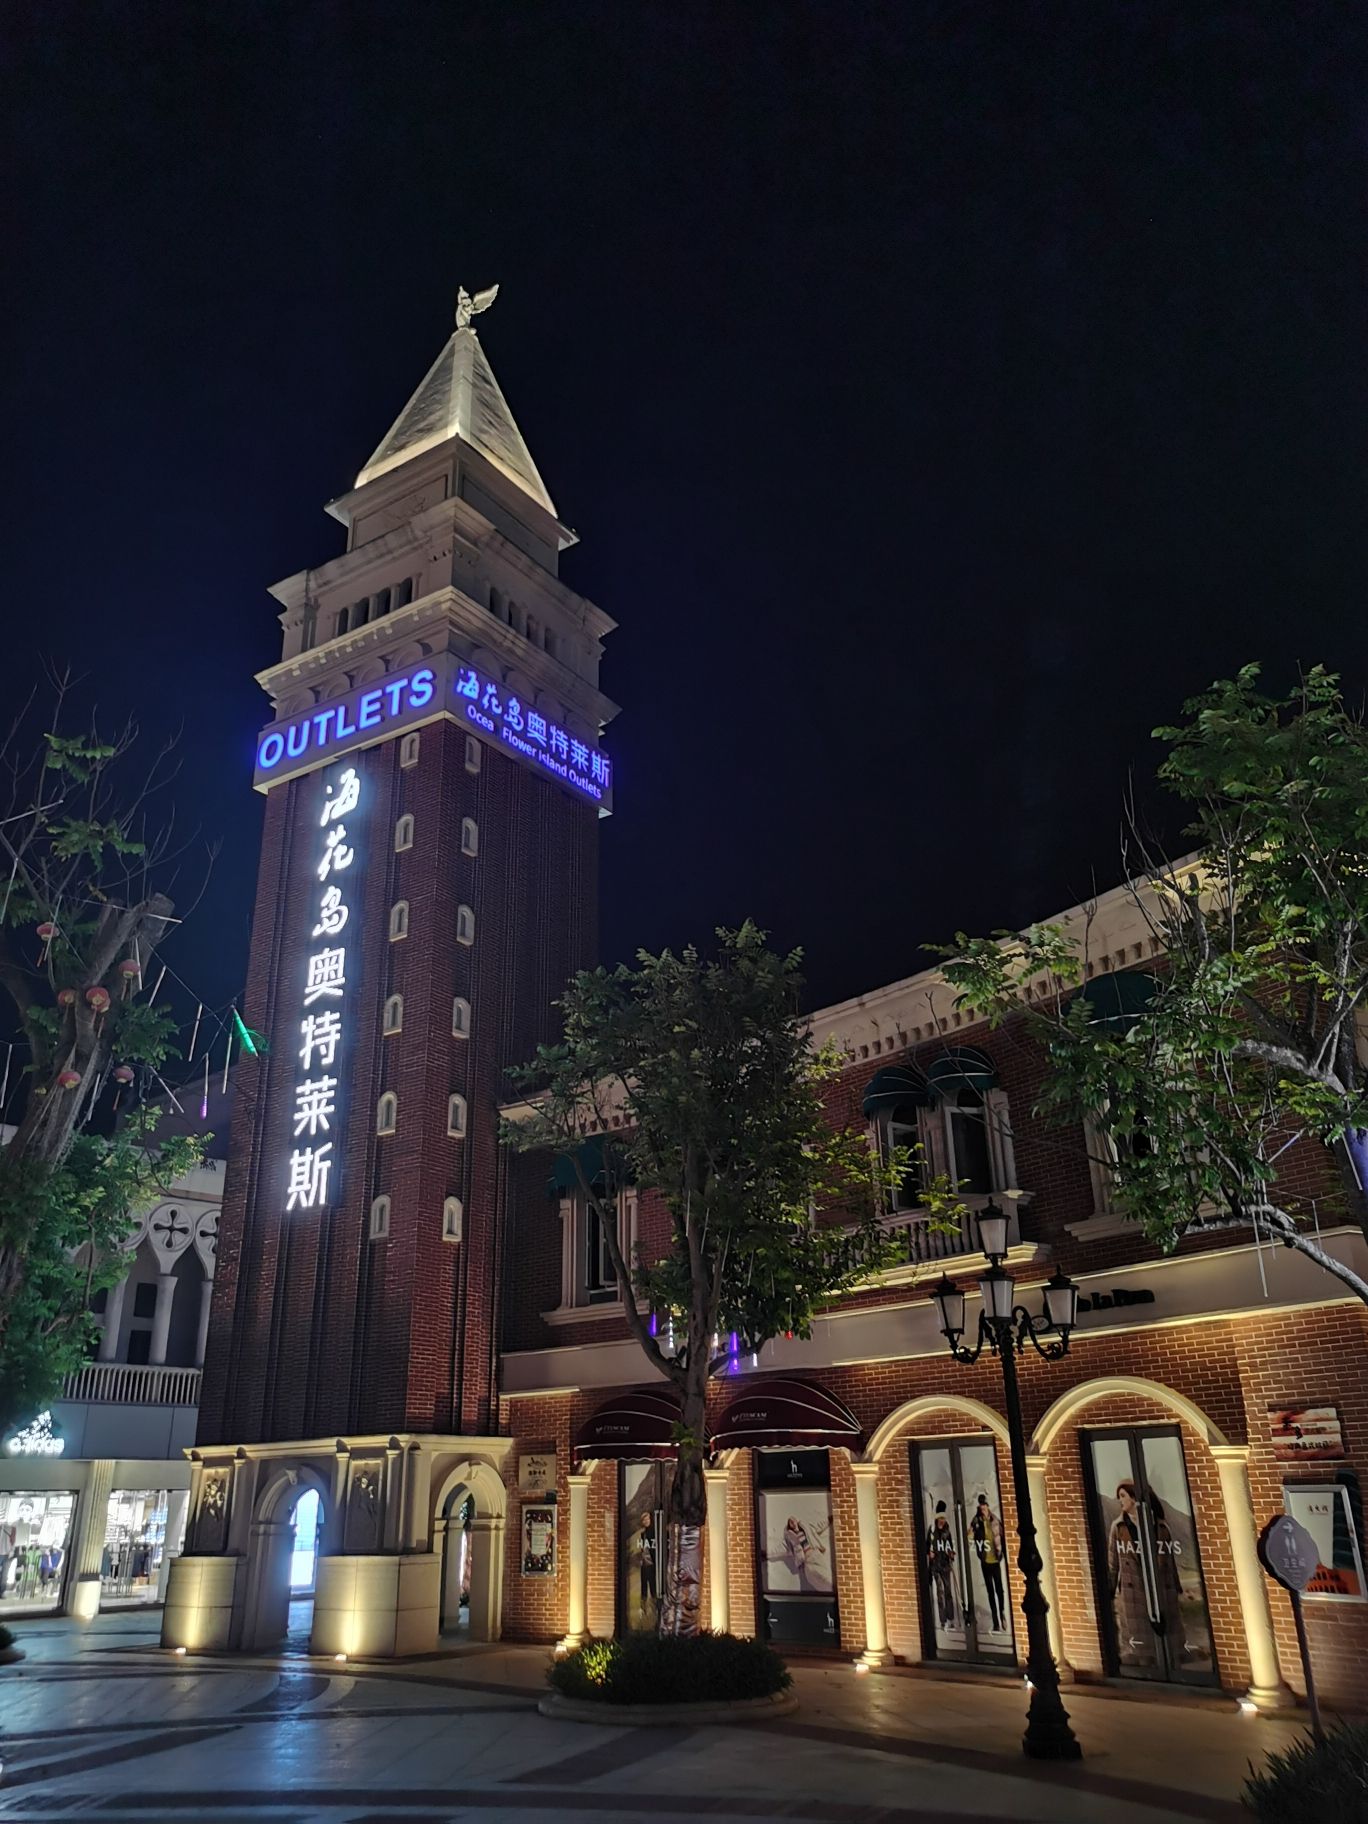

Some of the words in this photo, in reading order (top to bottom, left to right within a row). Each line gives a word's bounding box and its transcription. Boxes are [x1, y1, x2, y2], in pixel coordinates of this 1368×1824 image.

[258, 668, 434, 769] OUTLETS
[456, 667, 610, 788] 海花岛奥特莱斯
[467, 704, 500, 736] Ocea
[502, 726, 537, 757] Flower
[538, 749, 568, 777] Island
[568, 769, 602, 799] Outlets
[286, 767, 361, 1211] 海花岛奥特莱斯
[1156, 1539, 1182, 1555] ZYS
